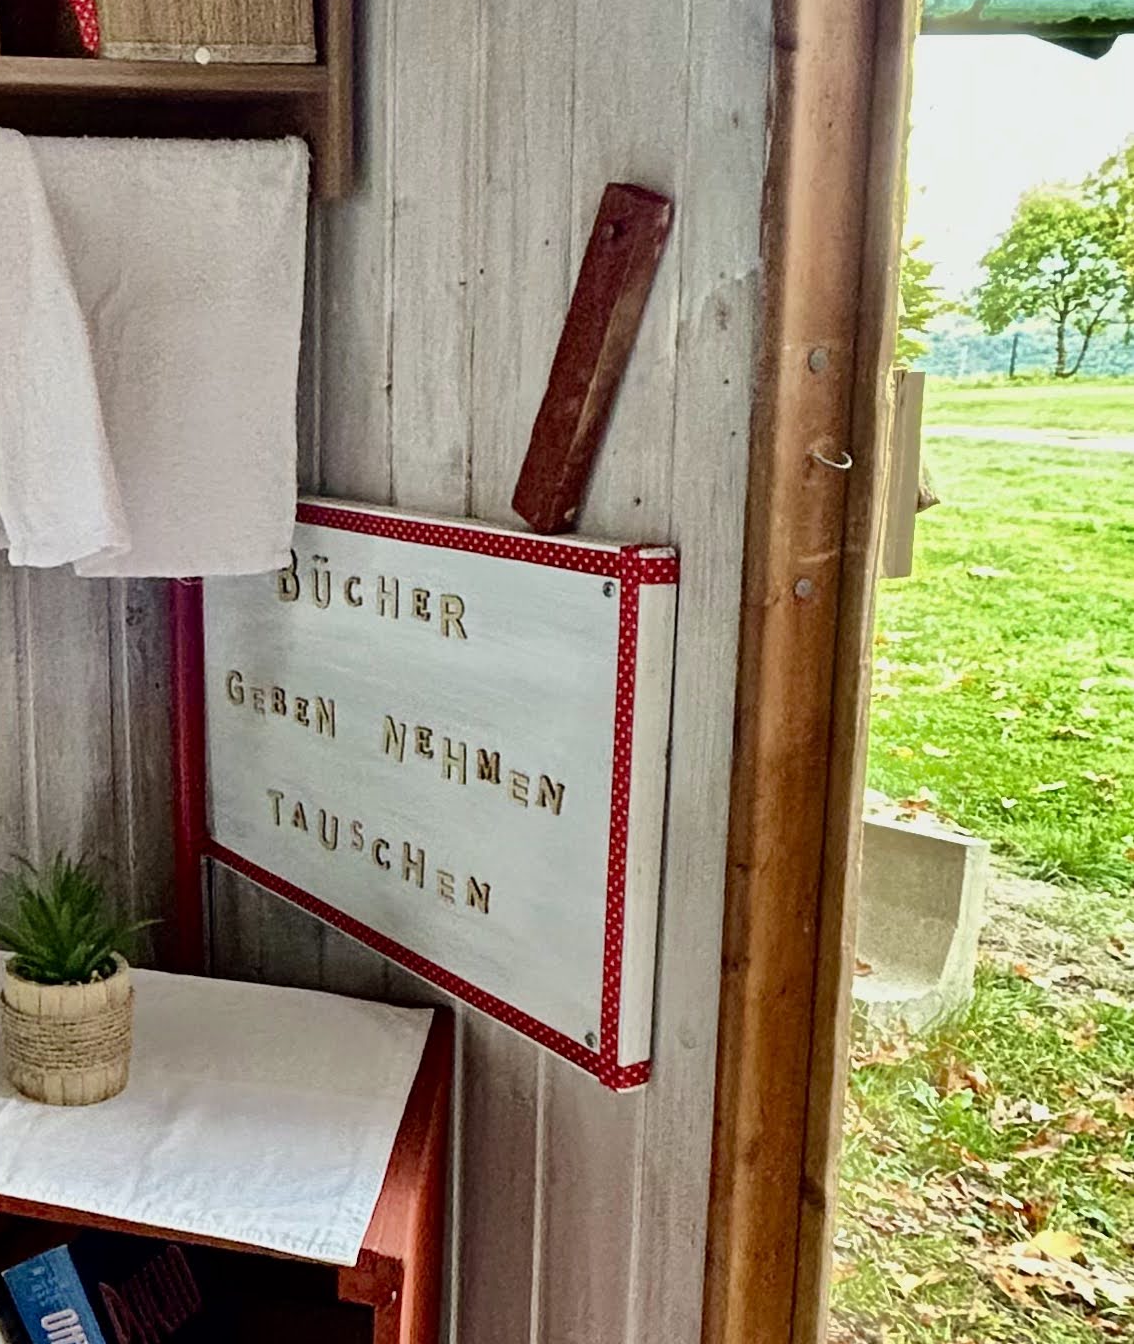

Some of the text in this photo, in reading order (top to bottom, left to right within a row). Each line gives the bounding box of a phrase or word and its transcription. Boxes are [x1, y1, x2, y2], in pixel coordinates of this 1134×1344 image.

[276, 549, 467, 639] BÜCHER
[226, 670, 566, 815] GEBEN NEHMEN
[267, 788, 491, 914] TAUSCHEN
